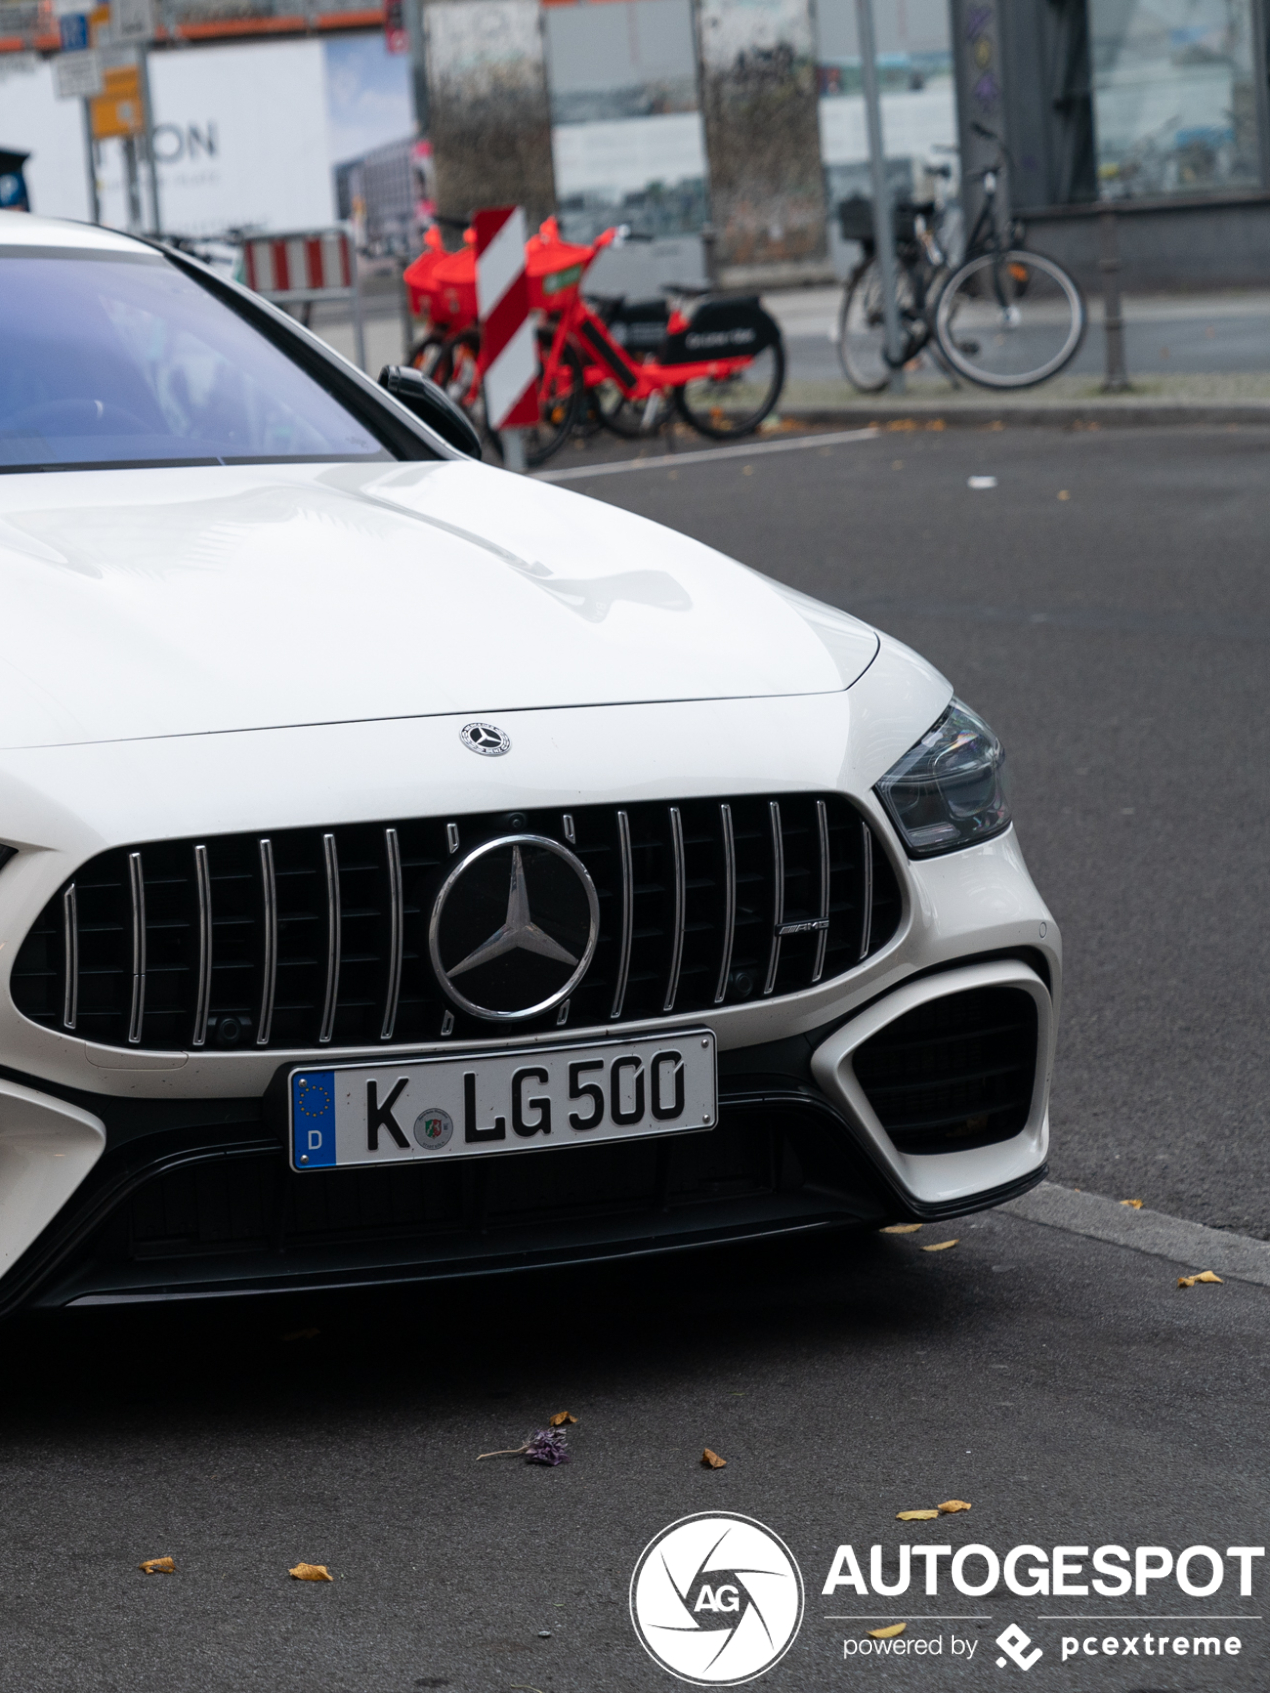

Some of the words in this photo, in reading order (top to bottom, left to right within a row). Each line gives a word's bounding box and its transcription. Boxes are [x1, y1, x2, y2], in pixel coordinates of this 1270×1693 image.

[139, 118, 219, 163] ON
[367, 1078, 411, 1151] K
[308, 1130, 322, 1150] D
